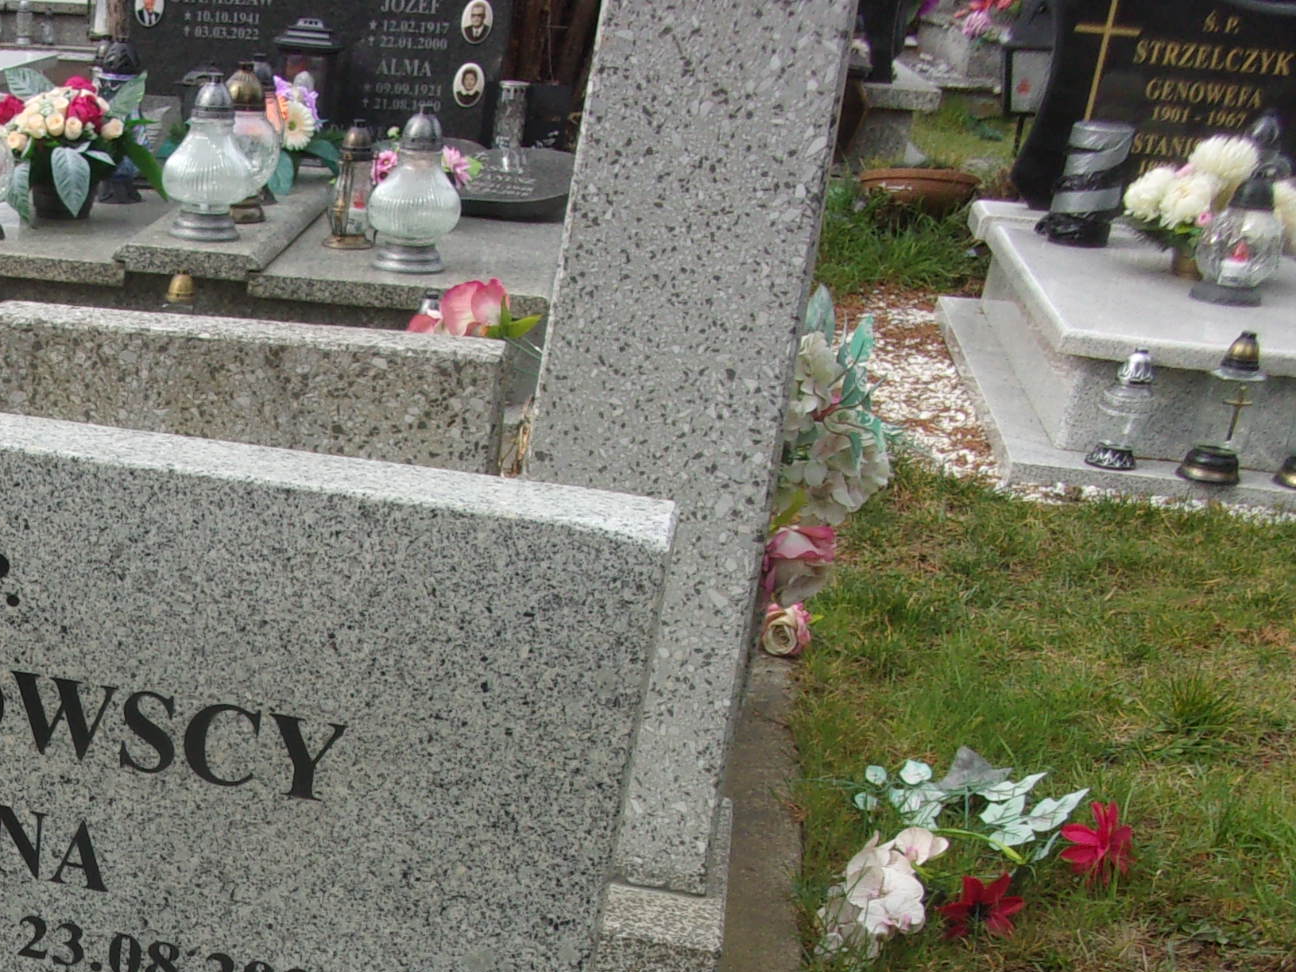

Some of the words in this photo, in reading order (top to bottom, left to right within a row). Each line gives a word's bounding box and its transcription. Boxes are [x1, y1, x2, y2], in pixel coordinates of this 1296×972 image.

[375, 59, 433, 78] ALMA
[1134, 39, 1295, 76] STRZELCZYK
[1145, 77, 1263, 110] GENOWEFA
[1151, 105, 1191, 124] 1901
[1206, 110, 1248, 129] 1967
